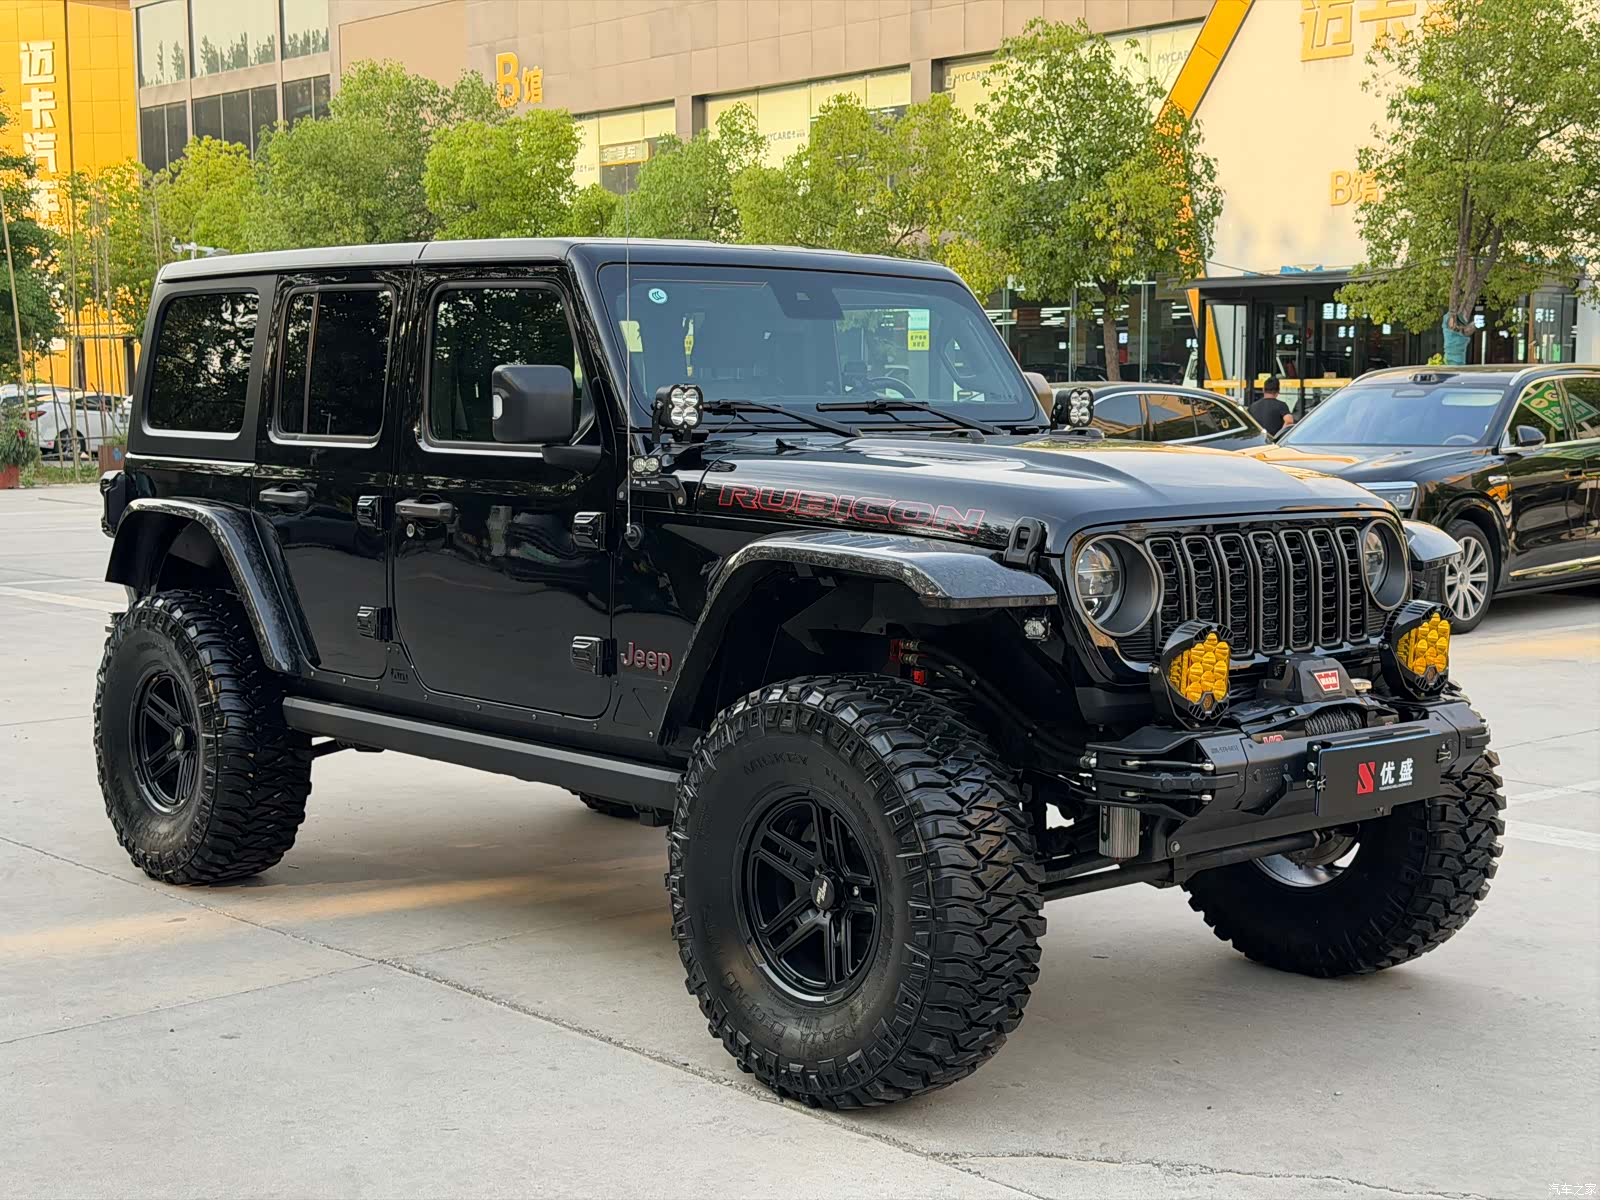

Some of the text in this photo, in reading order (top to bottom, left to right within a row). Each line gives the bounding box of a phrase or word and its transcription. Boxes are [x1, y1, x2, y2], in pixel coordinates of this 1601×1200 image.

[718, 482, 987, 535] RUBICON
[620, 640, 672, 676] Jeep
[1380, 757, 1414, 786] 优盛
